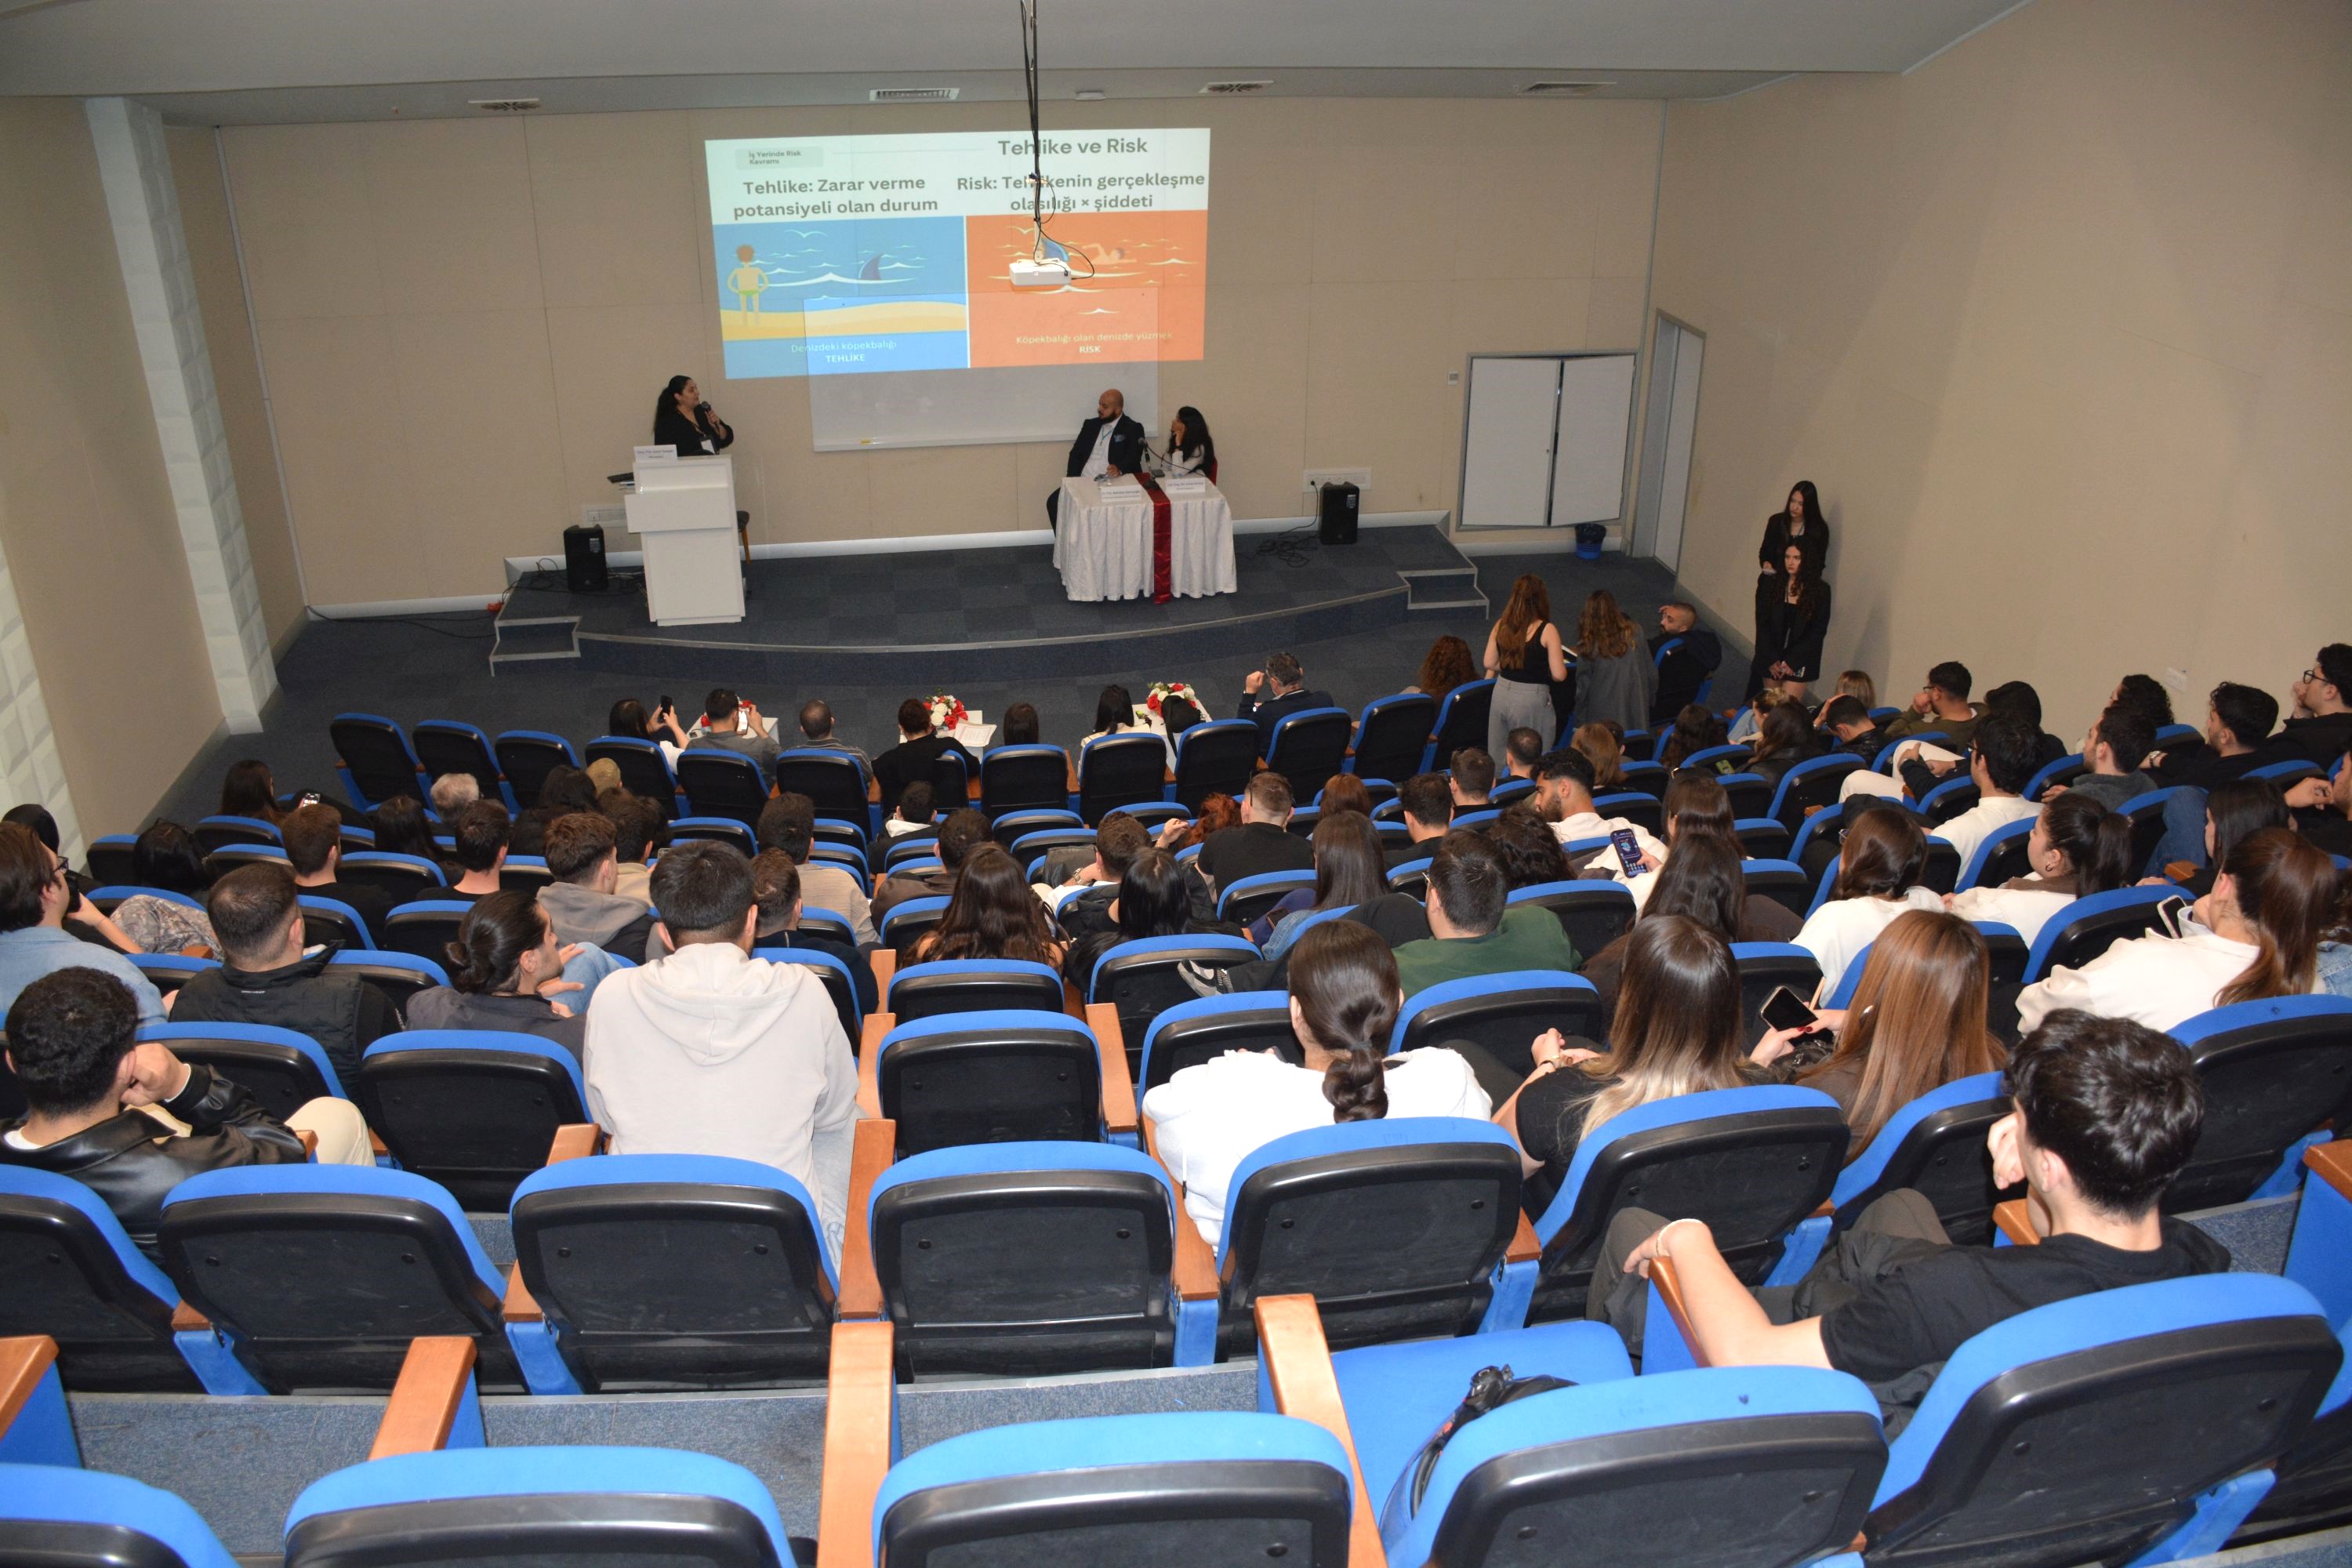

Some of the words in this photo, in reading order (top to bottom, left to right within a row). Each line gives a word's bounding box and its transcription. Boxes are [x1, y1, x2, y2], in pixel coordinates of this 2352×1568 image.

[998, 139, 1072, 155] Tehlike
[1077, 142, 1102, 154] ve
[1107, 137, 1148, 153] Risk
[743, 180, 813, 194] Tehlike:
[818, 179, 864, 192] Zarar
[869, 178, 926, 190] verme
[957, 176, 997, 190] Risk:
[1002, 174, 1092, 189] Tehikenin
[1098, 172, 1205, 190] gerçekleşme
[734, 201, 831, 220] potansiyeli
[837, 199, 874, 213] olan
[880, 198, 938, 212] durum
[1094, 194, 1152, 212] şiddeti
[1073, 333, 1094, 342] olan
[1097, 332, 1134, 341] denizde
[791, 343, 839, 353] Denizdeki
